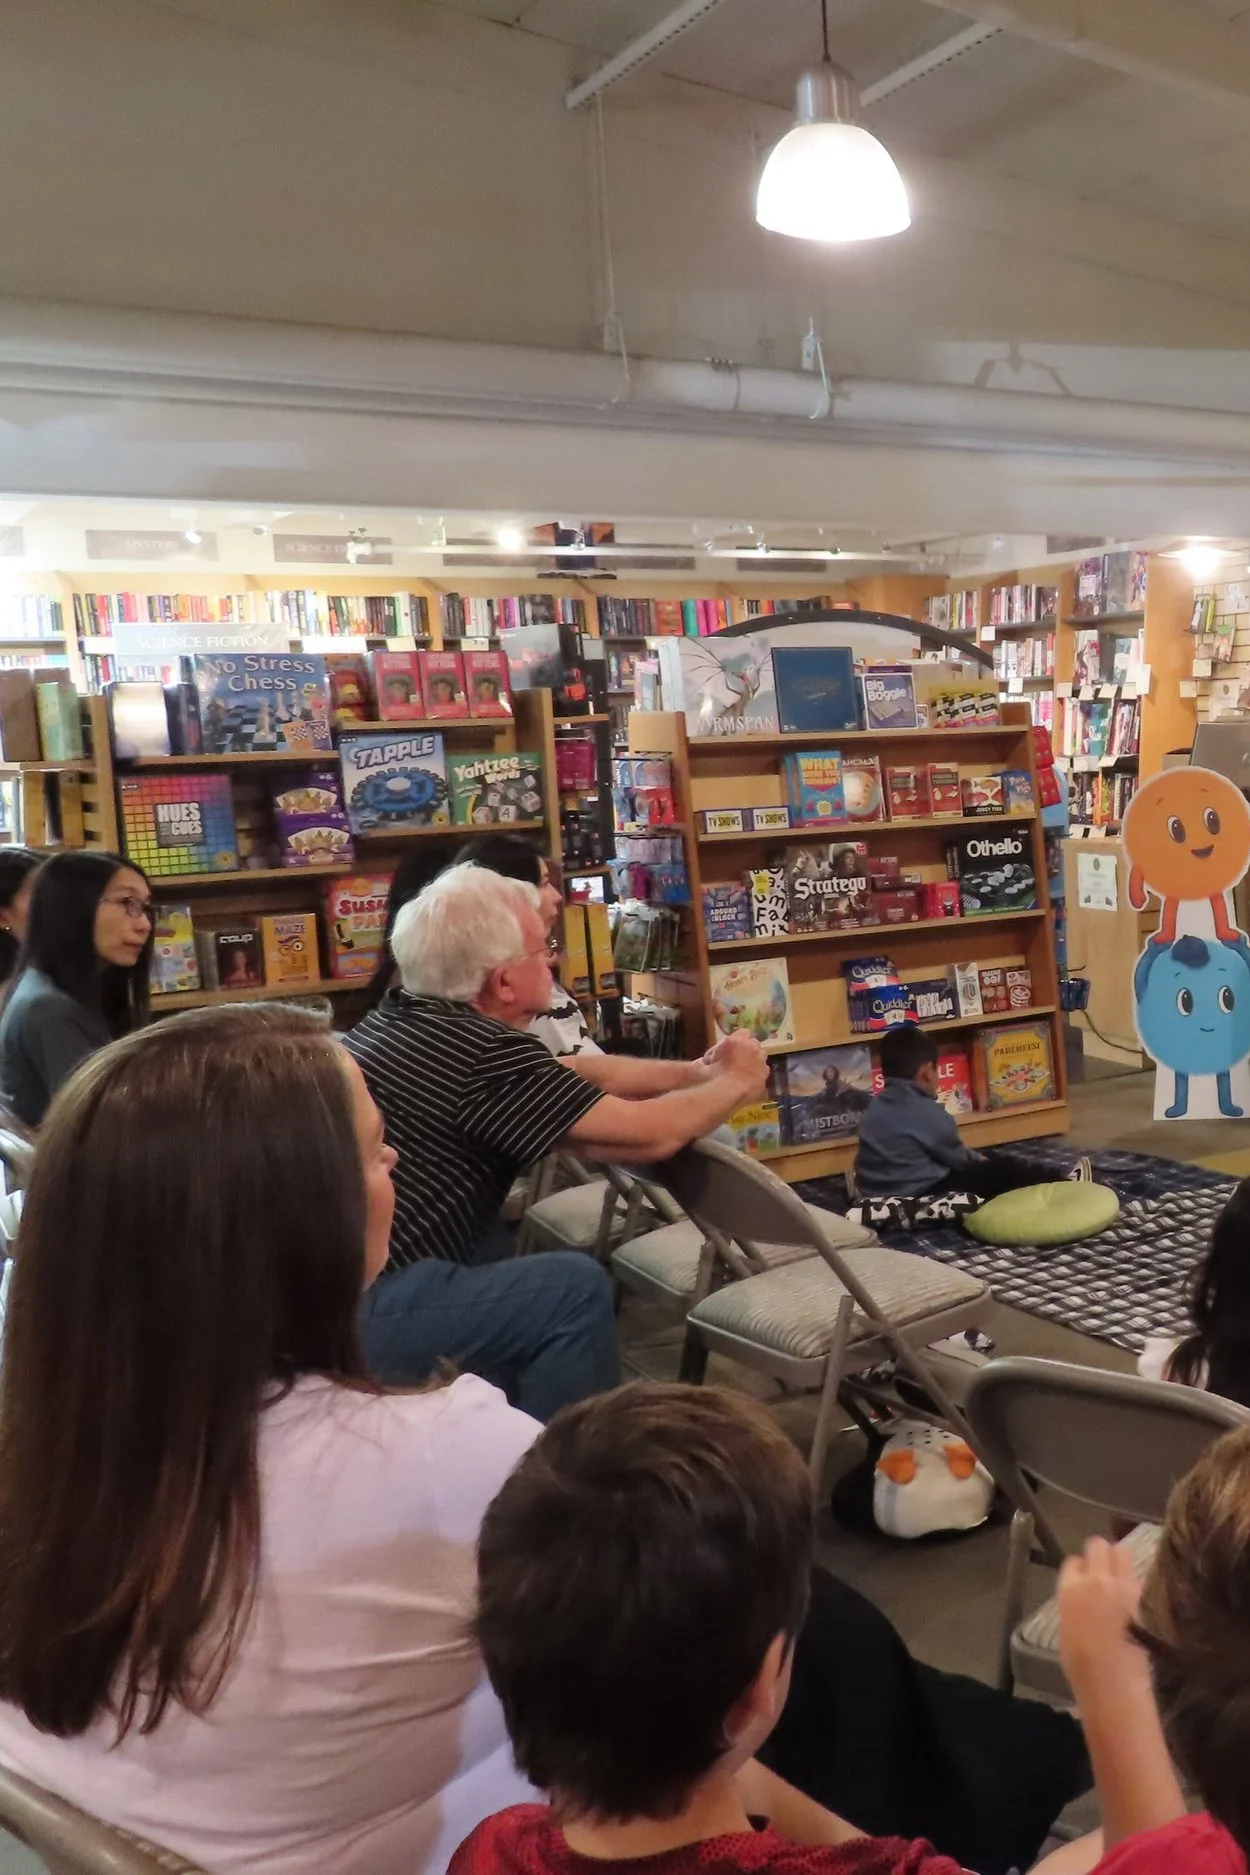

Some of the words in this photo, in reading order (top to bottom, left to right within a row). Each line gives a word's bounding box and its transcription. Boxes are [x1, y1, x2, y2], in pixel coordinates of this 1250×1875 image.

[126, 540, 179, 550] MYSTERY
[136, 636, 203, 649] SCIENCE
[206, 635, 269, 648] FICTION
[204, 658, 236, 675] No
[244, 655, 316, 674] Stress
[228, 674, 297, 692] Chess
[866, 679, 885, 692] Big
[868, 686, 907, 702] Boggle
[356, 735, 435, 770] TAPPLE
[453, 756, 520, 782] Yahtzee
[801, 758, 839, 771] WHAT
[157, 802, 201, 823] HUES
[756, 814, 765, 825] TV
[765, 812, 787, 825] SHOWS
[171, 821, 203, 836] CUES
[708, 818, 718, 828] TV
[718, 815, 741, 827] SHOWS
[966, 837, 1022, 858] Othello
[794, 876, 867, 901] Stratego
[339, 899, 386, 915] SUSH
[710, 906, 738, 916] AROUND
[715, 914, 736, 922] BLOCK
[274, 924, 306, 936] MAZE
[852, 964, 893, 979] Quiddler
[872, 998, 913, 1014] Quiddler
